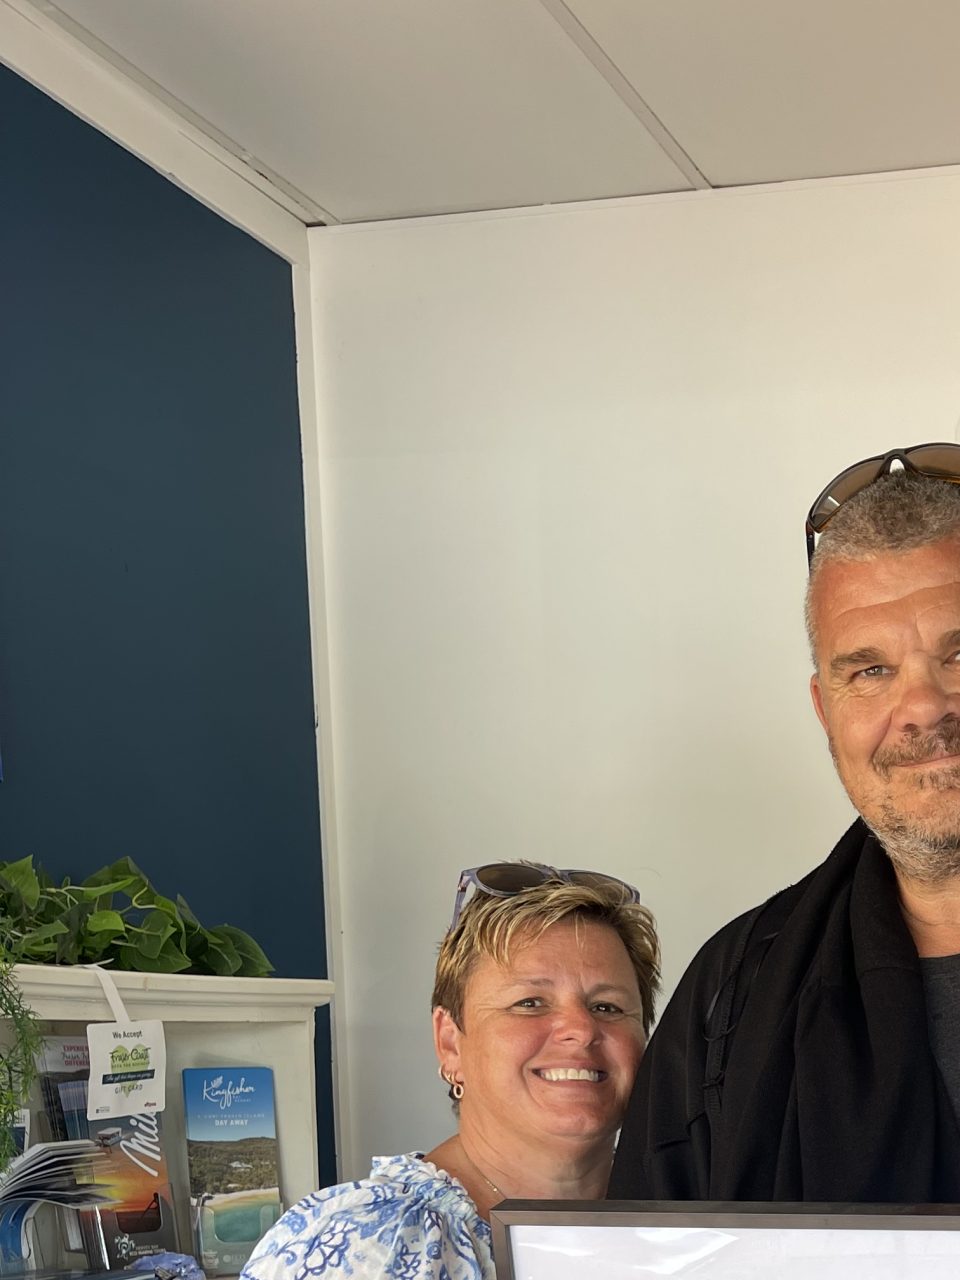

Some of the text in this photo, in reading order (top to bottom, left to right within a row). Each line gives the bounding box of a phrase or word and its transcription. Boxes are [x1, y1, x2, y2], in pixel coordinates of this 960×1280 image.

[112, 1030, 143, 1039] We Accept
[115, 1083, 143, 1094] GIFT CARD
[203, 1077, 256, 1110] Kingfisher
